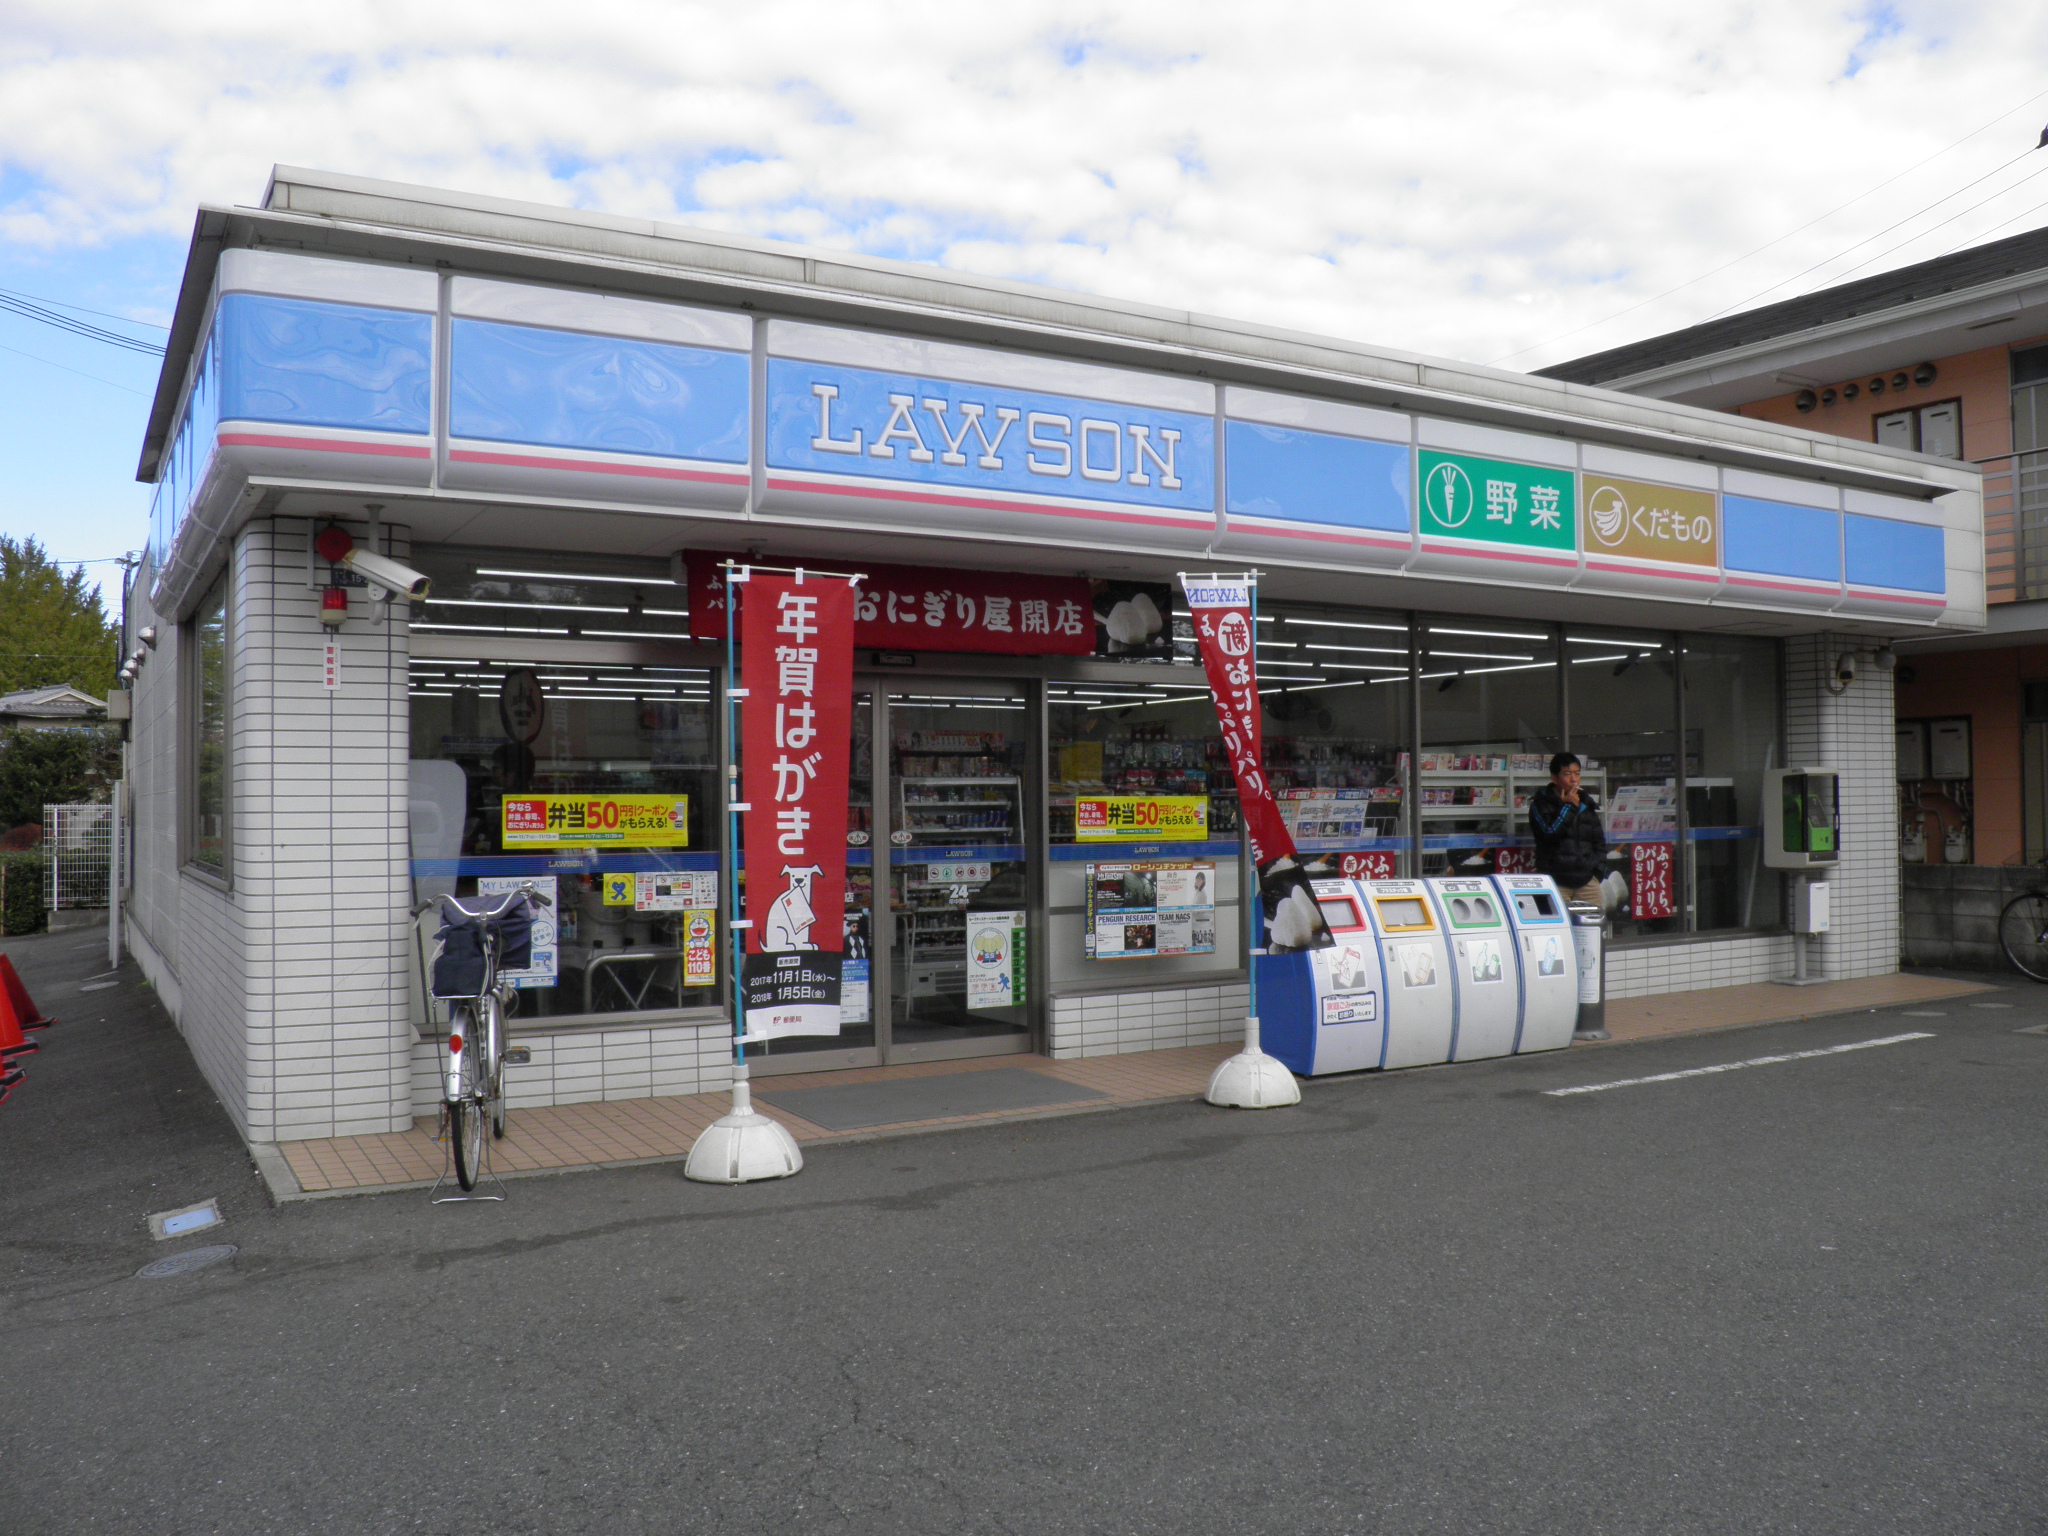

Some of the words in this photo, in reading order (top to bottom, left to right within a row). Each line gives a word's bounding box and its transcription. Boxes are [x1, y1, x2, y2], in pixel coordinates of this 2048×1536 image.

[811, 382, 1182, 490] LAWSON
[1486, 479, 1561, 530] 野菜
[1631, 505, 1712, 544] くだもの
[772, 591, 822, 855] 年賀はがき
[507, 802, 532, 812] 今なら
[1079, 803, 1097, 811] 今なら
[482, 881, 497, 890] MY
[499, 880, 540, 889] LAWN
[1645, 846, 1658, 915] パリパリ。
[1656, 845, 1671, 914] ふっくら、
[949, 884, 969, 898] 24
[1098, 915, 1124, 923] PENGUIN
[1125, 914, 1155, 922] RESEARCH
[688, 949, 711, 961] こども
[688, 961, 712, 974] 110番
[751, 992, 773, 1004] 2018年
